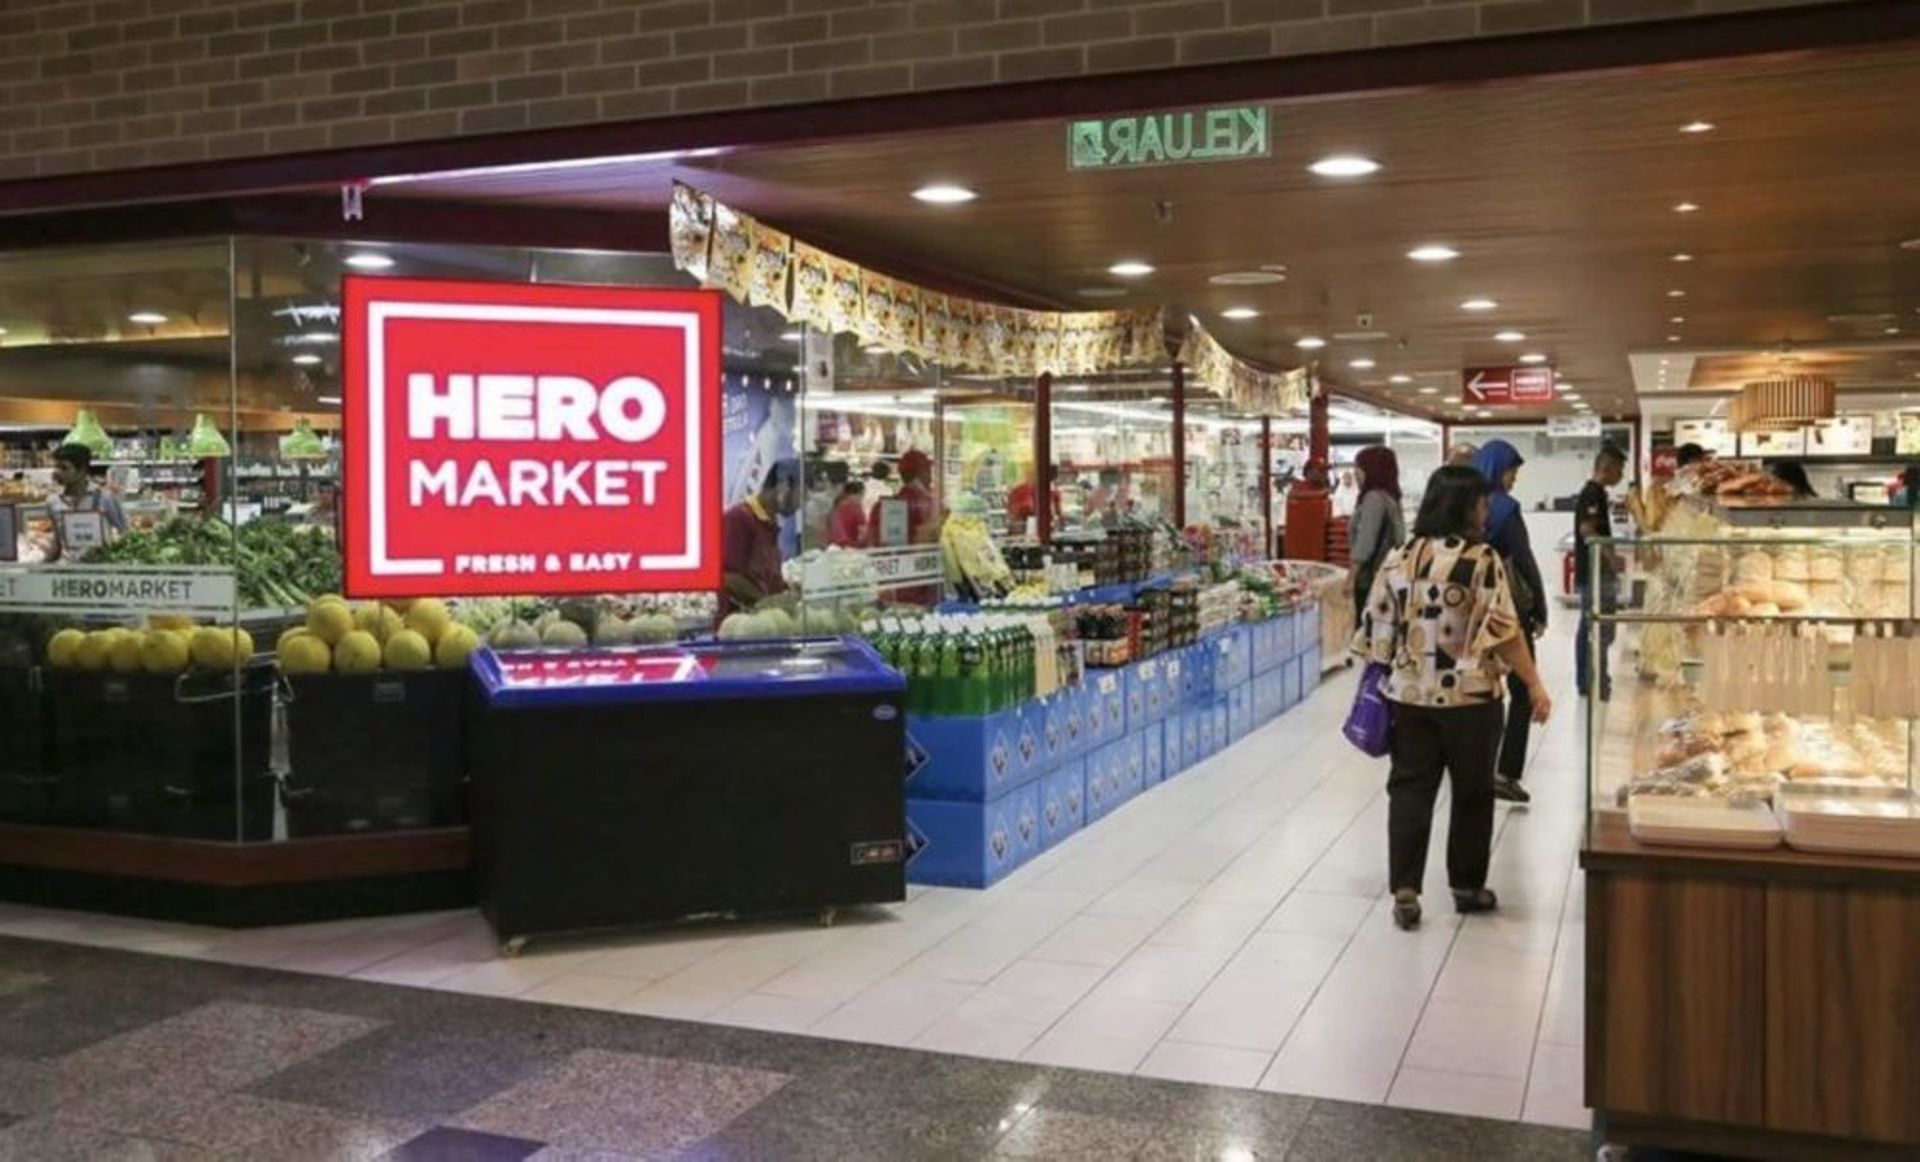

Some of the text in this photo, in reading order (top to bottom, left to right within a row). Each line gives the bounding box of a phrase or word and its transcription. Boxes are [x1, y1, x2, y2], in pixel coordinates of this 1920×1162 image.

[408, 373, 667, 442] HERO
[409, 459, 668, 507] MARKET
[455, 552, 632, 573] FRESH & EASY
[52, 577, 193, 600] HEROMARKET
